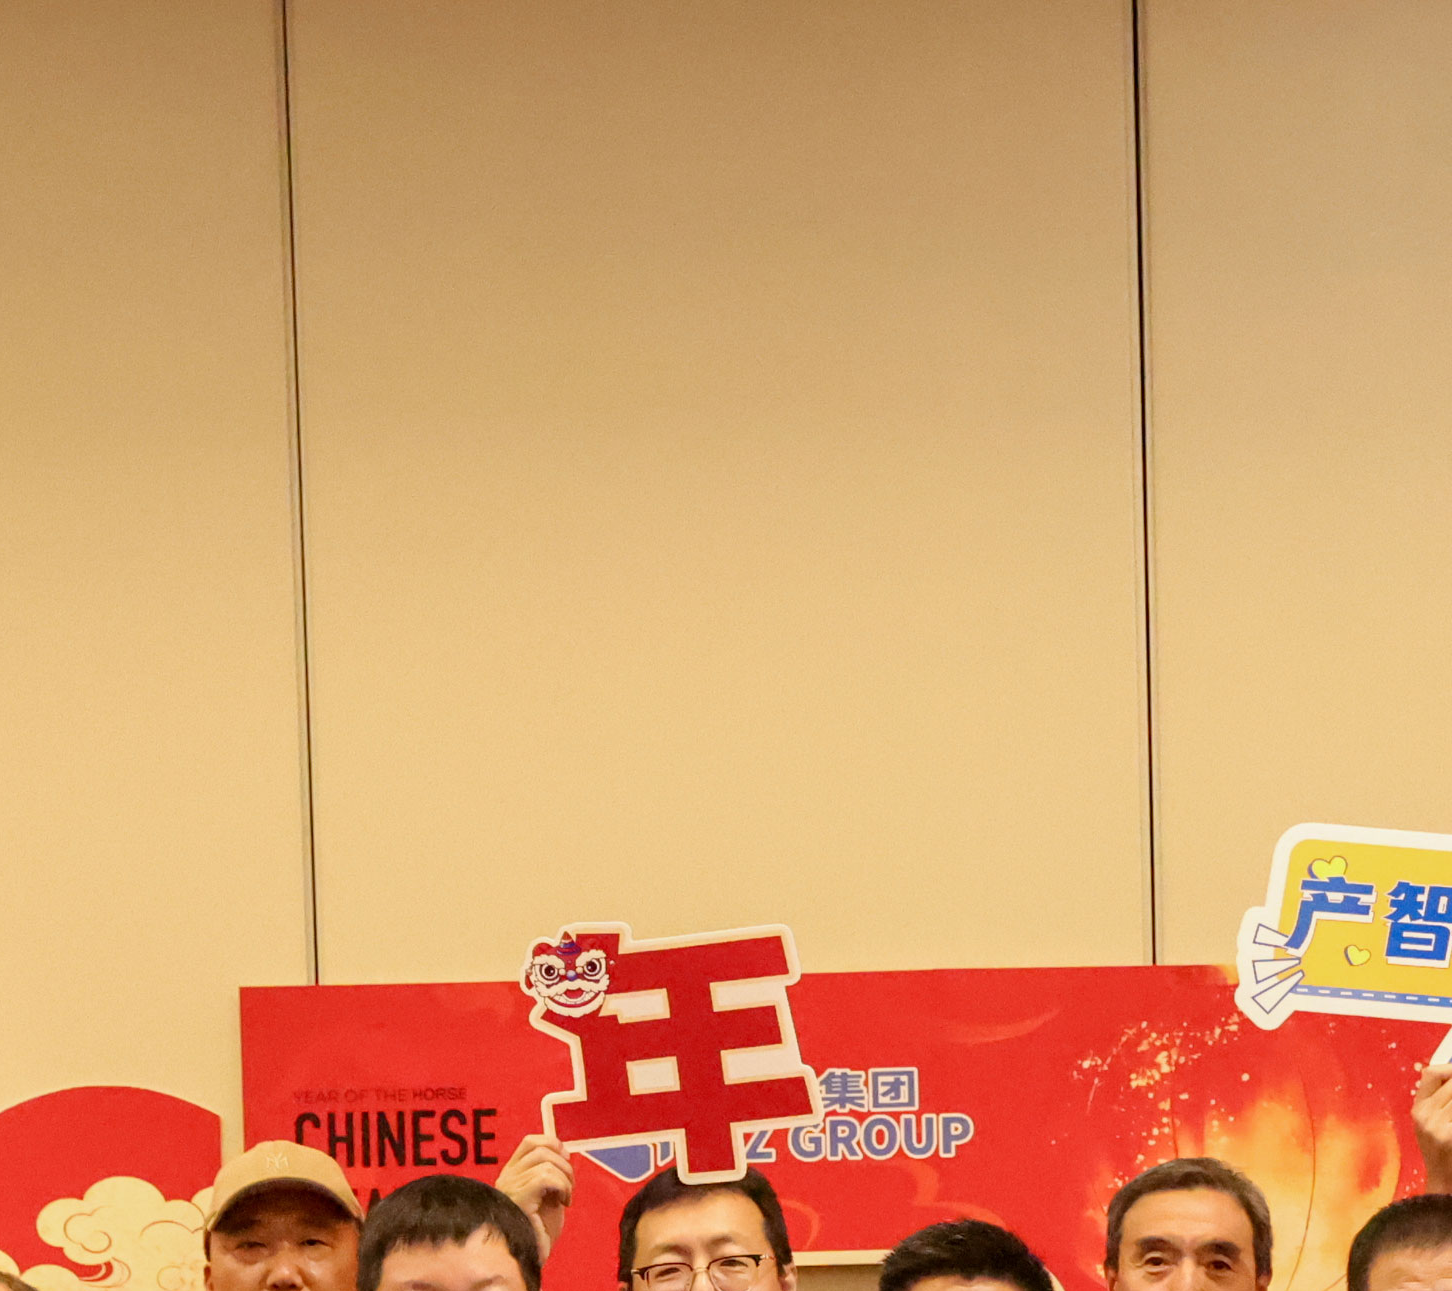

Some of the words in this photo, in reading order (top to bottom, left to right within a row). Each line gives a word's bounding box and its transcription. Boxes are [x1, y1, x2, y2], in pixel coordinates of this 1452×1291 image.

[546, 933, 816, 1175] 年
[294, 1090, 339, 1104] YEAR
[344, 1089, 368, 1103] OF
[374, 1088, 407, 1102] THE
[412, 1087, 467, 1100] HORSE
[295, 1108, 498, 1168] CHINESE
[791, 1115, 971, 1160] GROUP
